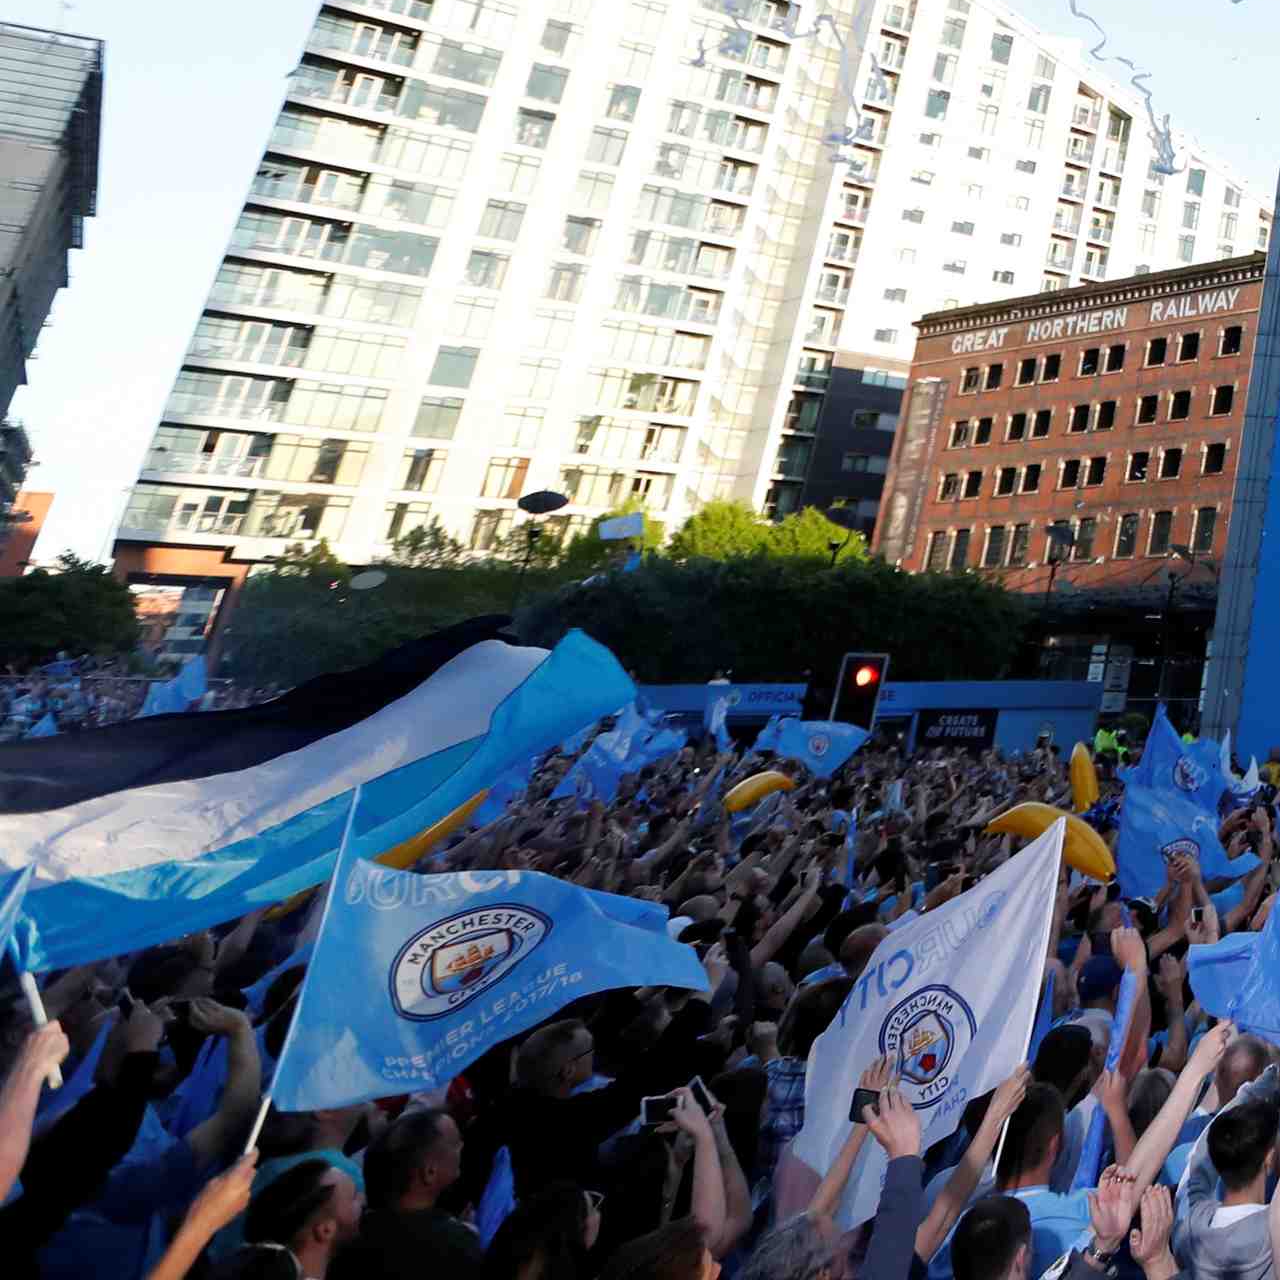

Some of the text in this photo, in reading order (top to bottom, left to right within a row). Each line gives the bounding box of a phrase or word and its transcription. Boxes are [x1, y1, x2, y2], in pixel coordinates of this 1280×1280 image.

[952, 287, 1240, 354] GREAT NORTHERN RAILWAY
[407, 912, 536, 965] MANCHESTER
